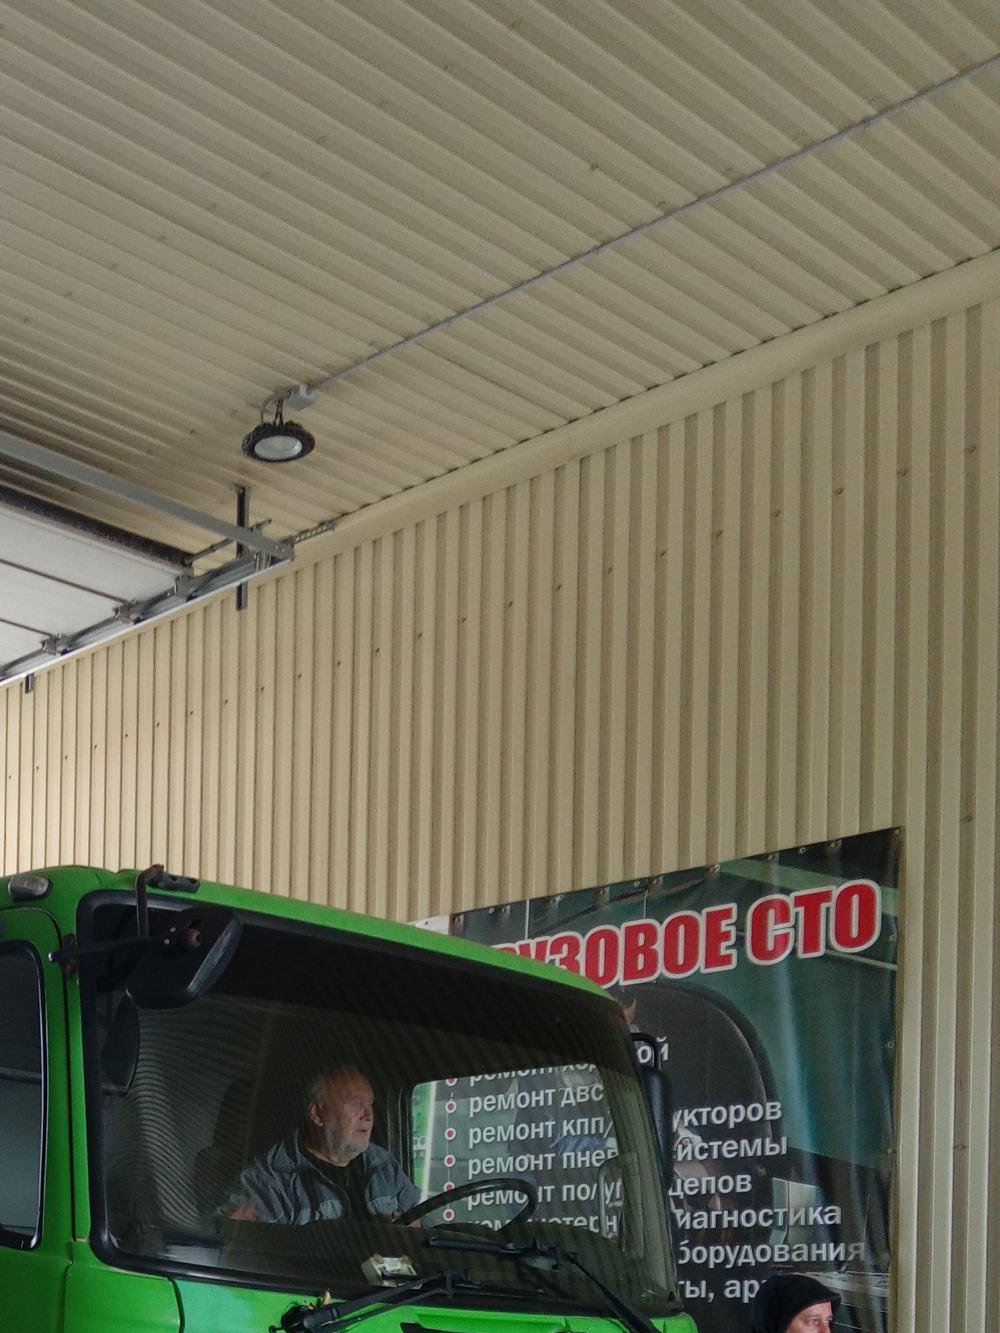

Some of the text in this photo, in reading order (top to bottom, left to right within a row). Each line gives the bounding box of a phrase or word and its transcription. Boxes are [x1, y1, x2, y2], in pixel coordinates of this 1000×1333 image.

[746, 879, 881, 965] СТО
[469, 1088, 556, 1117] ремонт
[468, 1120, 556, 1149] ремонт
[467, 1152, 556, 1179] ремонт
